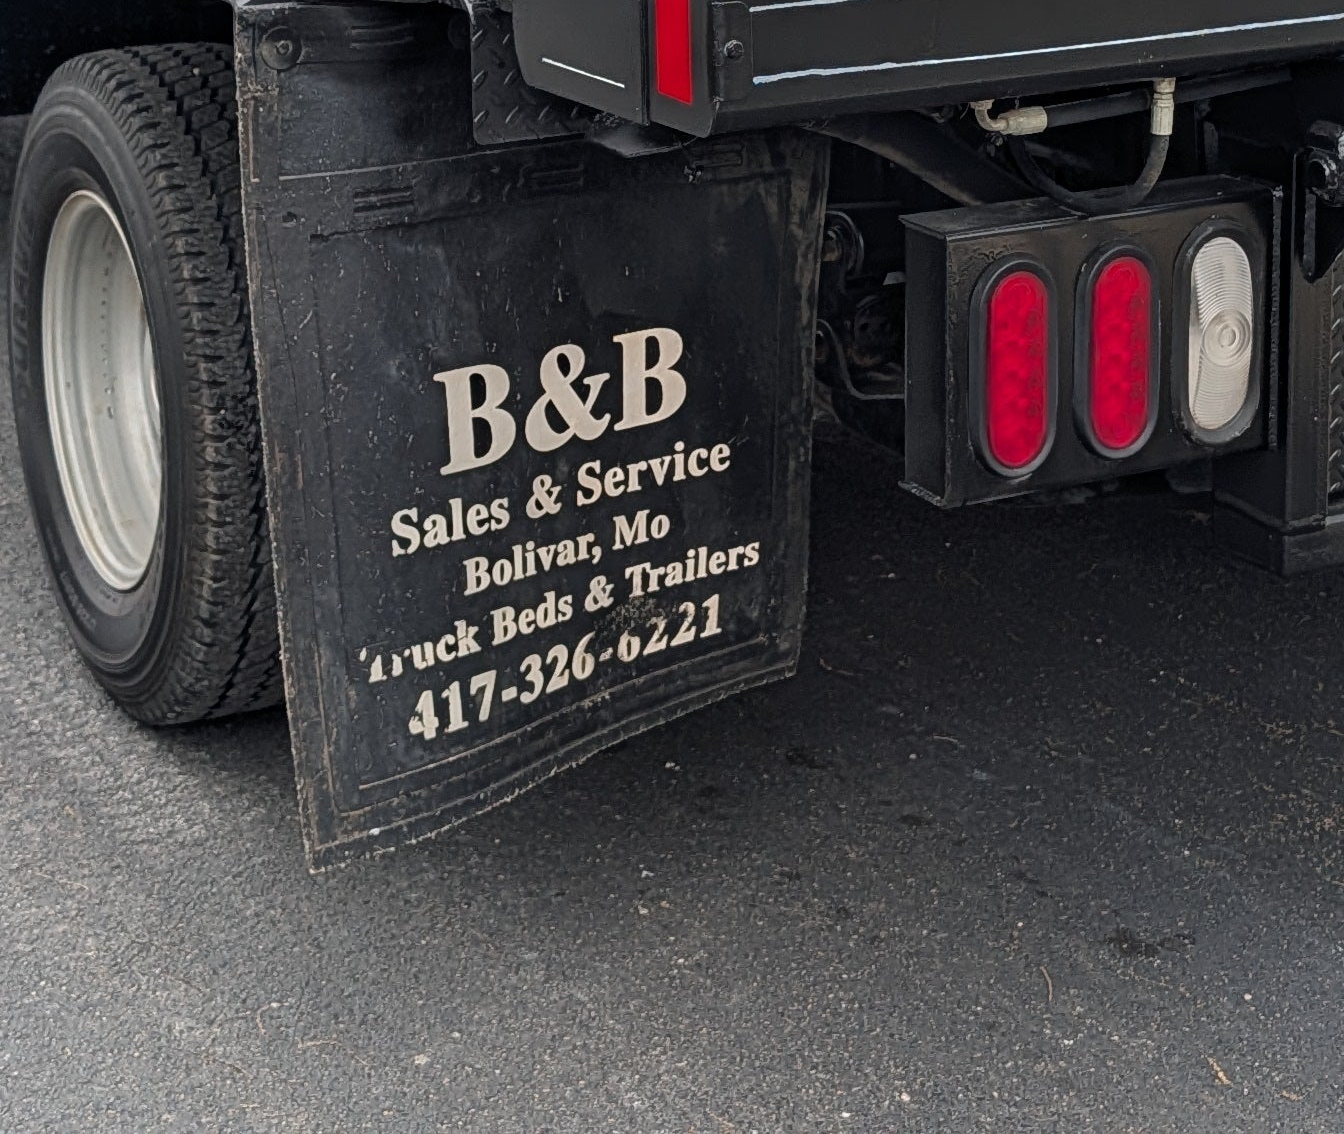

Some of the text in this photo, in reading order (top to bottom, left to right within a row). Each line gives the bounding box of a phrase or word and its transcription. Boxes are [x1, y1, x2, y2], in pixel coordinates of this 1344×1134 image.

[432, 327, 687, 476] B&B
[390, 440, 731, 558] Sales & Service
[462, 509, 671, 596] Bolivar, Mo
[489, 590, 573, 646] Beds
[584, 575, 615, 612] &
[624, 541, 760, 598] Trailers
[407, 593, 723, 741] 417-326-6221
